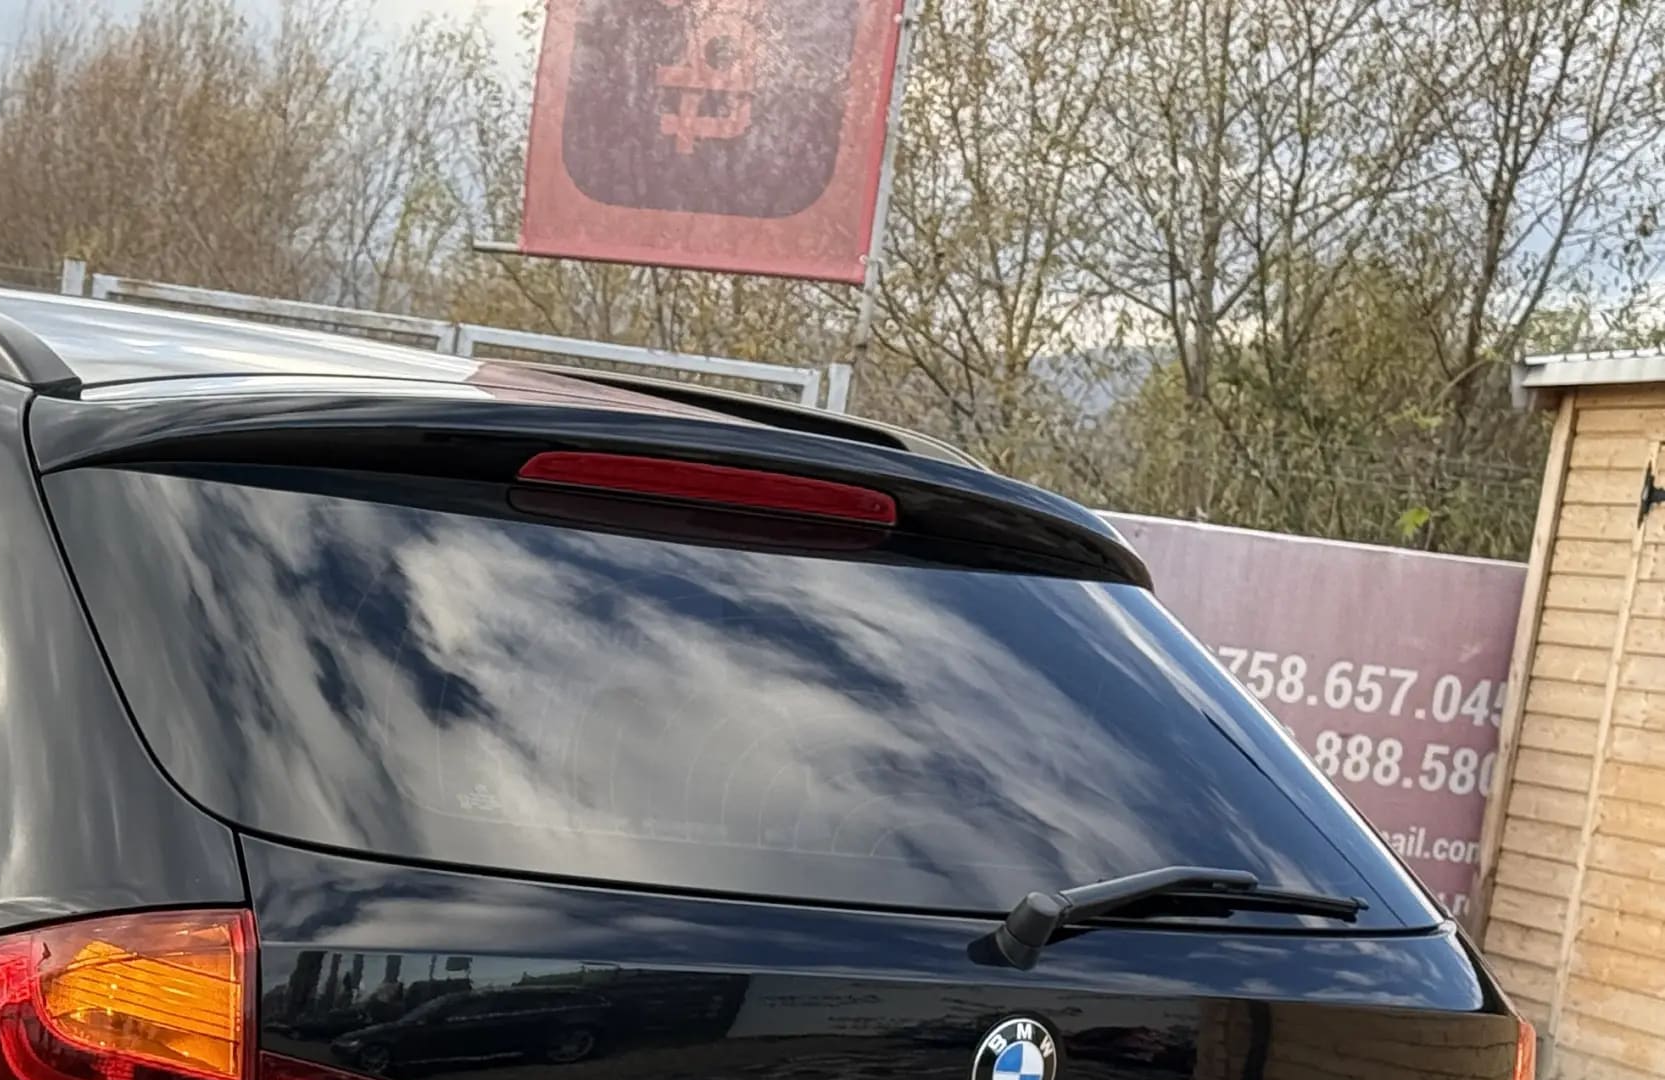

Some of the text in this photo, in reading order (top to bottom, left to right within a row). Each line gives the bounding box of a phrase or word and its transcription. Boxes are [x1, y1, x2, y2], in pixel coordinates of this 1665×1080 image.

[656, 0, 756, 154] tb
[1207, 644, 1507, 728] 758.657.04
[1380, 826, 1482, 864] ail.co
[988, 1023, 1054, 1058] BMW
